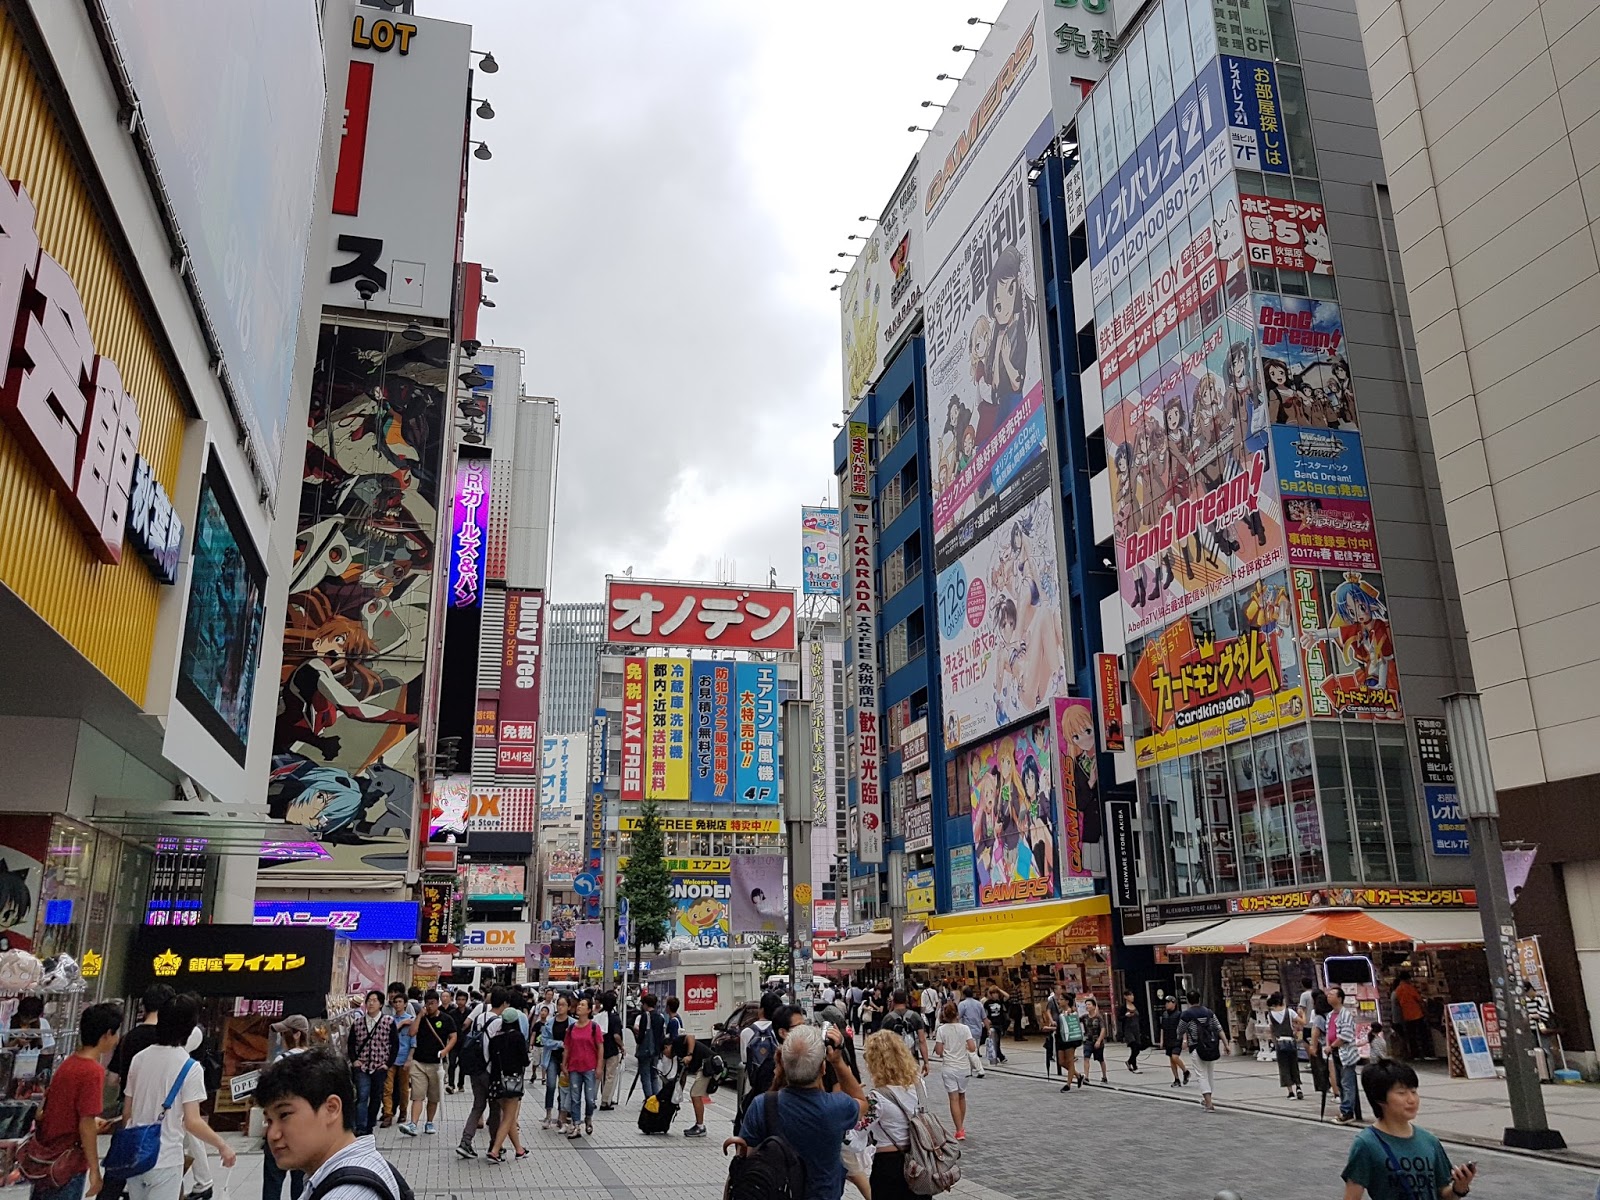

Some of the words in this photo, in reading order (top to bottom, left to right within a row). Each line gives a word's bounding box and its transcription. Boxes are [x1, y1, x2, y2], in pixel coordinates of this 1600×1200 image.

[352, 15, 417, 56] LOT
[1219, 37, 1244, 50] 管理
[1245, 27, 1267, 36] 当ビル
[1246, 37, 1269, 54] 8F
[1229, 58, 1249, 126] レオパレス21
[924, 14, 1038, 217] GAMERS
[1254, 67, 1282, 165] お部屋探しは
[1232, 132, 1255, 143] 当ビル
[1095, 83, 1213, 250] レオパレス21
[1210, 148, 1227, 176] 7F
[1233, 144, 1257, 161] 7F
[1242, 198, 1321, 221] ホビーランド
[330, 234, 387, 290] ス
[1251, 246, 1271, 261] 6F
[1276, 257, 1304, 268] 2号店
[1201, 267, 1216, 292] 6F
[929, 291, 972, 368] コミックス
[852, 437, 867, 494] まんが喫茶
[1294, 470, 1319, 481] BanG
[1320, 471, 1352, 483] Dream!
[1125, 510, 1174, 572] BanG
[1288, 532, 1374, 551] 事前登録受付中!
[1290, 547, 1332, 560] 2017年春
[1333, 550, 1375, 563] 配信予定!
[854, 523, 872, 612] TAKARADA
[507, 595, 518, 636] Flagship
[517, 597, 542, 641] Duty
[612, 592, 791, 641] オノデン
[506, 639, 517, 666] Store
[516, 645, 540, 689] Free
[1151, 629, 1282, 730] カードキングダム
[626, 663, 642, 700] 免税
[857, 662, 875, 707] 免税商店
[1333, 688, 1398, 711] カードキングダム
[503, 725, 532, 739] 免税
[625, 702, 642, 739] TAX
[698, 675, 712, 778] お見積り無料です
[714, 667, 729, 797] 防犯カメラ販売開始!!
[740, 691, 756, 768] 大特売中!!
[757, 668, 775, 782] エアコン扇風機
[501, 751, 532, 763] 면세점
[592, 716, 606, 784] Panasonic
[624, 743, 641, 792] FREE
[1427, 763, 1448, 772] 当ビル
[744, 787, 770, 800] 4F
[478, 819, 500, 827] Store
[592, 792, 603, 849] ONODEN
[696, 819, 727, 831] 免税店
[1063, 753, 1083, 874] GAMERS
[1120, 835, 1128, 856] STORE
[1437, 839, 1458, 849] 当ビル
[981, 876, 1050, 905] GAMERS
[1120, 856, 1131, 900] ALIENWARE
[1250, 892, 1308, 908] カードキングダム
[1378, 890, 1464, 904] カードキングダム
[975, 913, 1015, 923] GAMERS
[188, 953, 306, 973] 銀座ライオン
[1385, 1157, 1434, 1171] COOL
